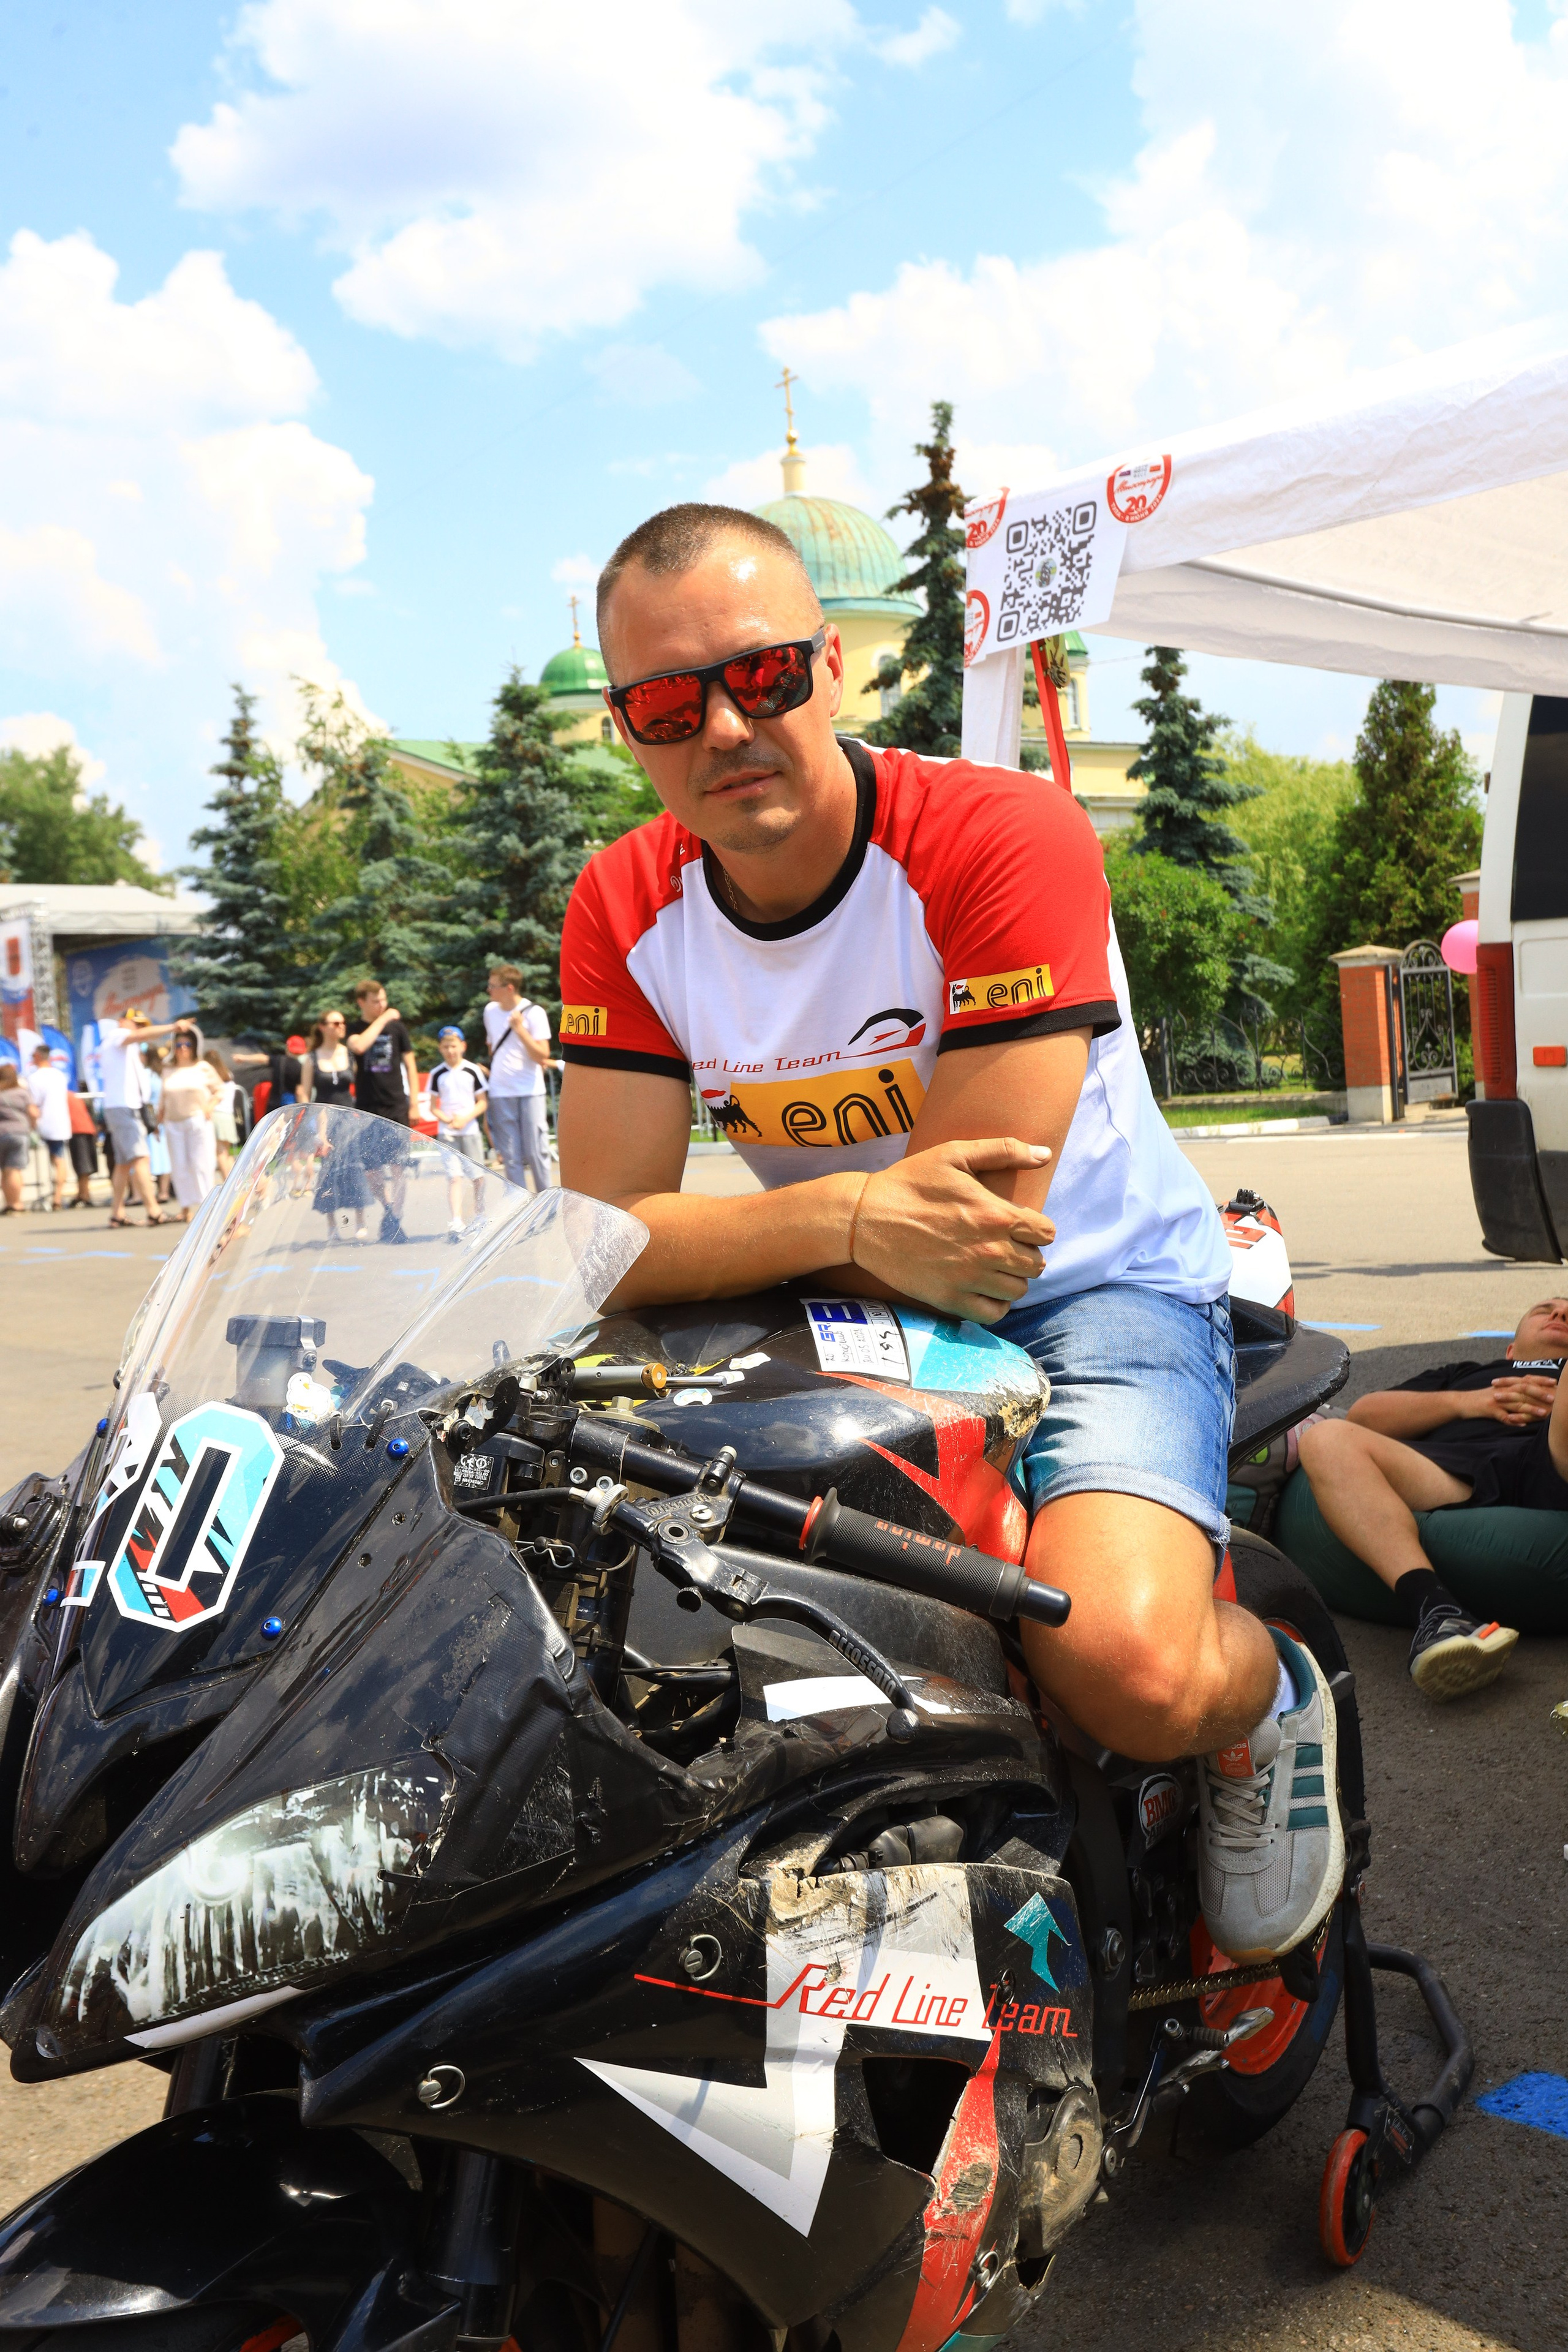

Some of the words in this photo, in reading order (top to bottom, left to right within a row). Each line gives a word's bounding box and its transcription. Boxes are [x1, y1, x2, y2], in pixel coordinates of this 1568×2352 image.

[1125, 494, 1147, 514] 20
[987, 967, 1046, 1009] eni
[565, 1008, 600, 1036] eni
[692, 1058, 717, 1070] ed
[723, 1060, 764, 1072] Line
[774, 1050, 841, 1071] Team
[782, 1069, 914, 1147] eni
[876, 1520, 962, 1565] domino
[773, 1962, 891, 2021] Red
[891, 1975, 968, 2027] Line
[981, 1983, 1078, 2038] Team
